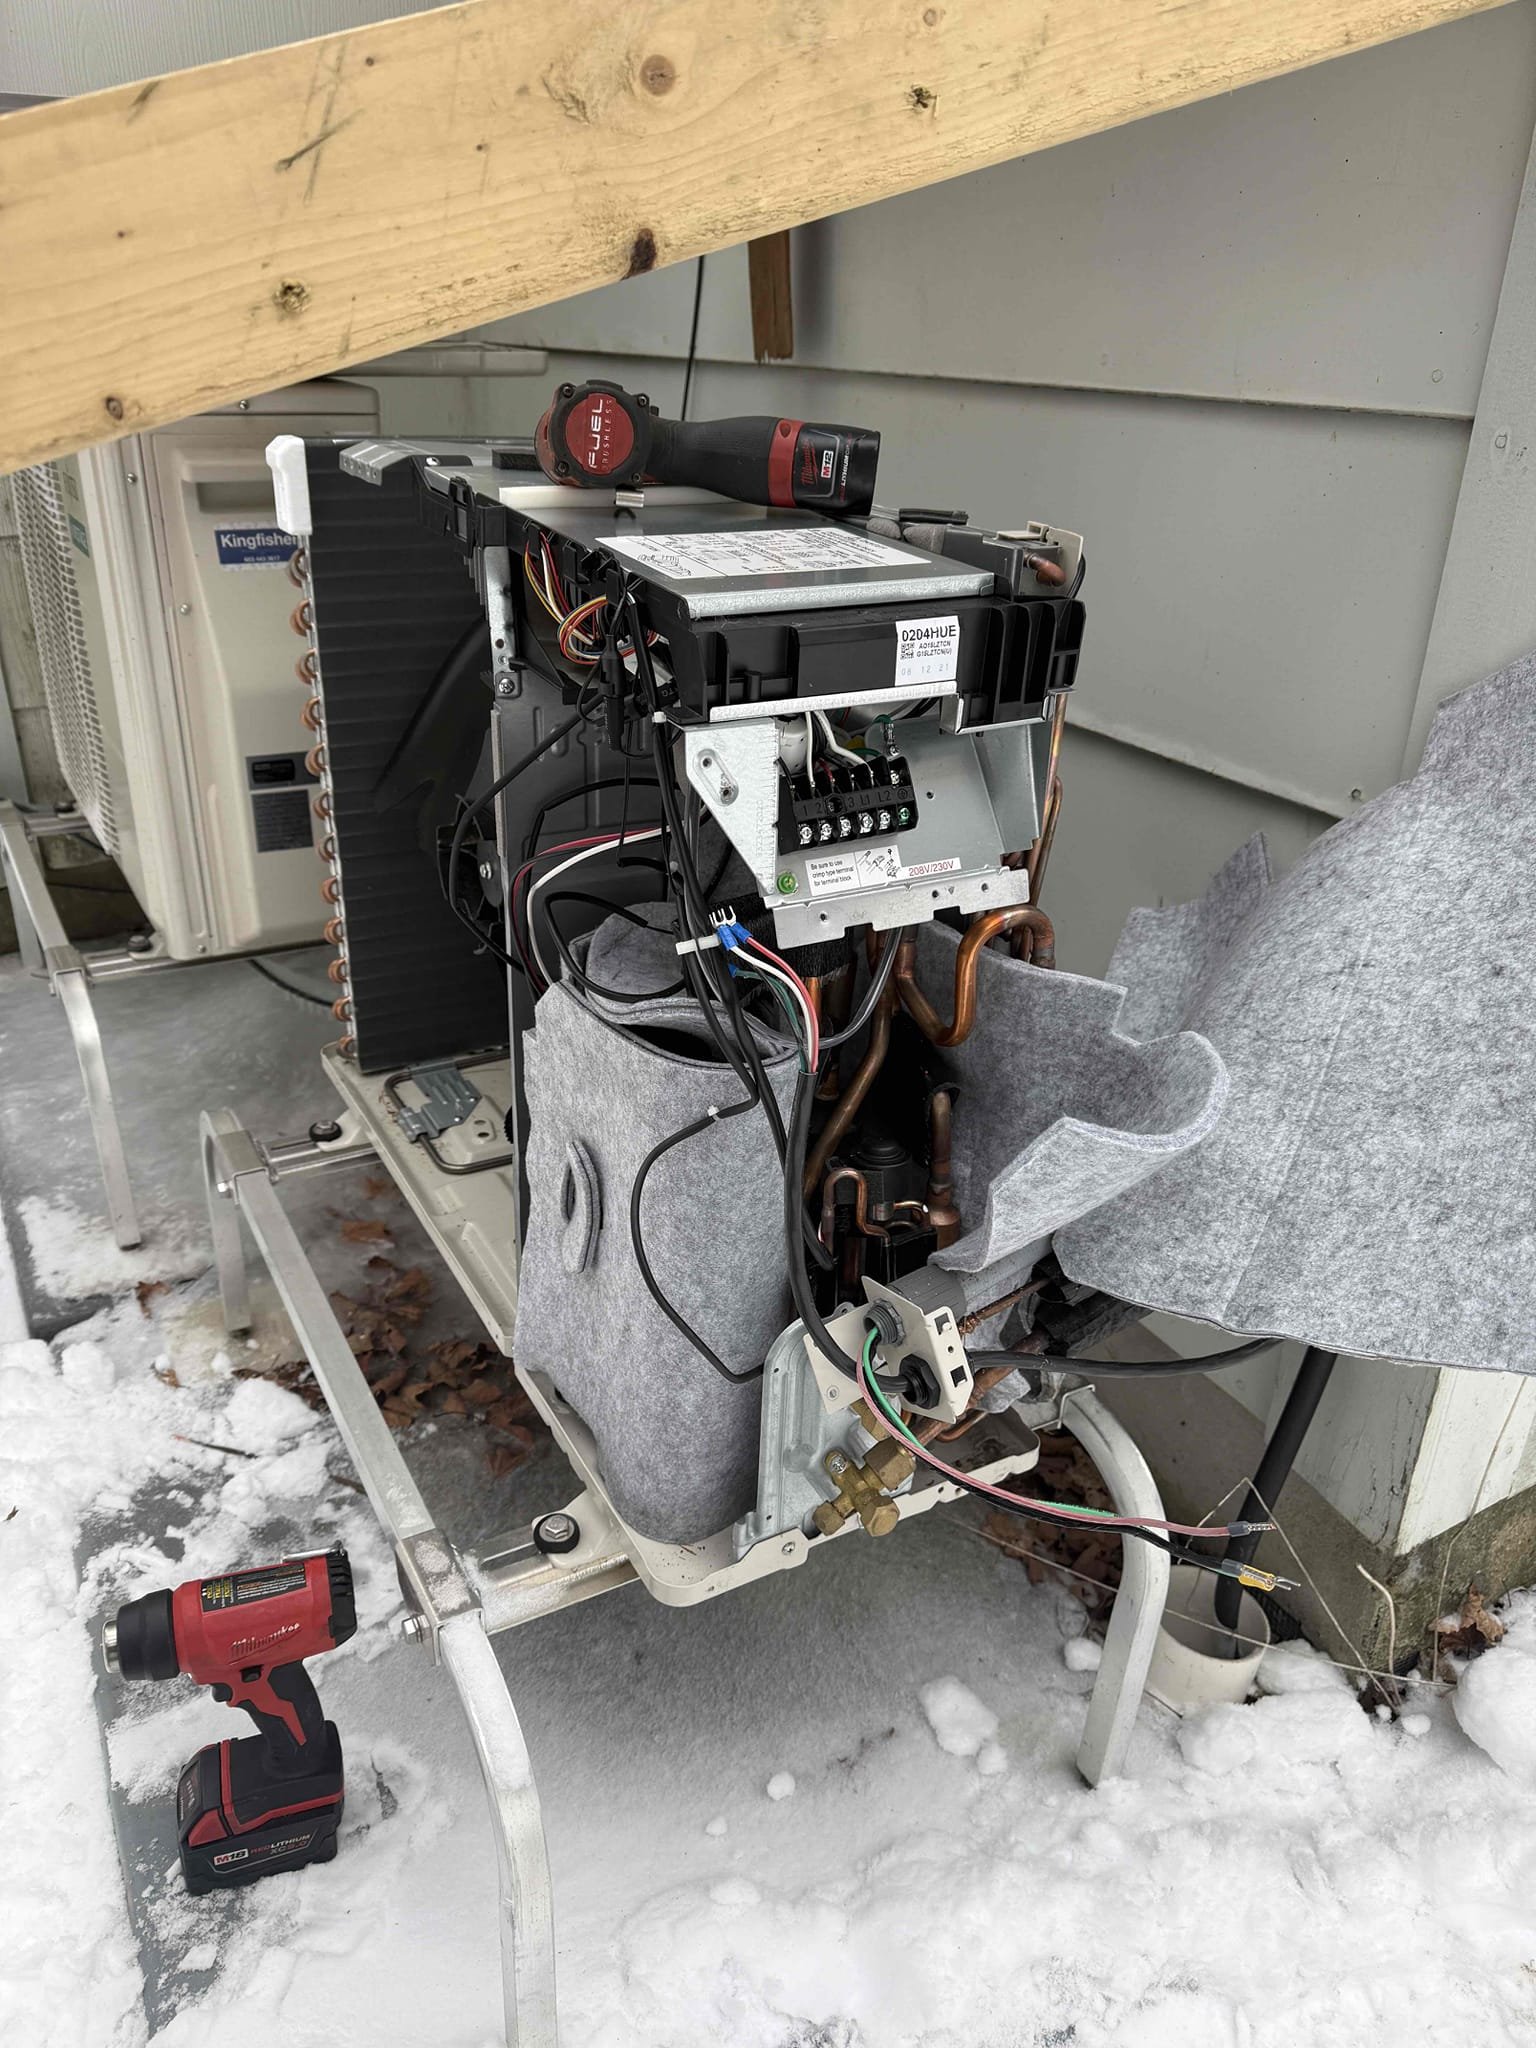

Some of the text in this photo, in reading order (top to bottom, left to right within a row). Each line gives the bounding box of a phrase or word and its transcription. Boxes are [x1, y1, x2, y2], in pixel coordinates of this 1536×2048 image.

[588, 398, 603, 469] FUEL
[822, 451, 833, 477] M12
[902, 625, 957, 642] 0204HUE
[848, 796, 855, 808] 3
[909, 859, 954, 877] 208V/230V
[215, 1834, 311, 1864] M18 REDLITHIUM
